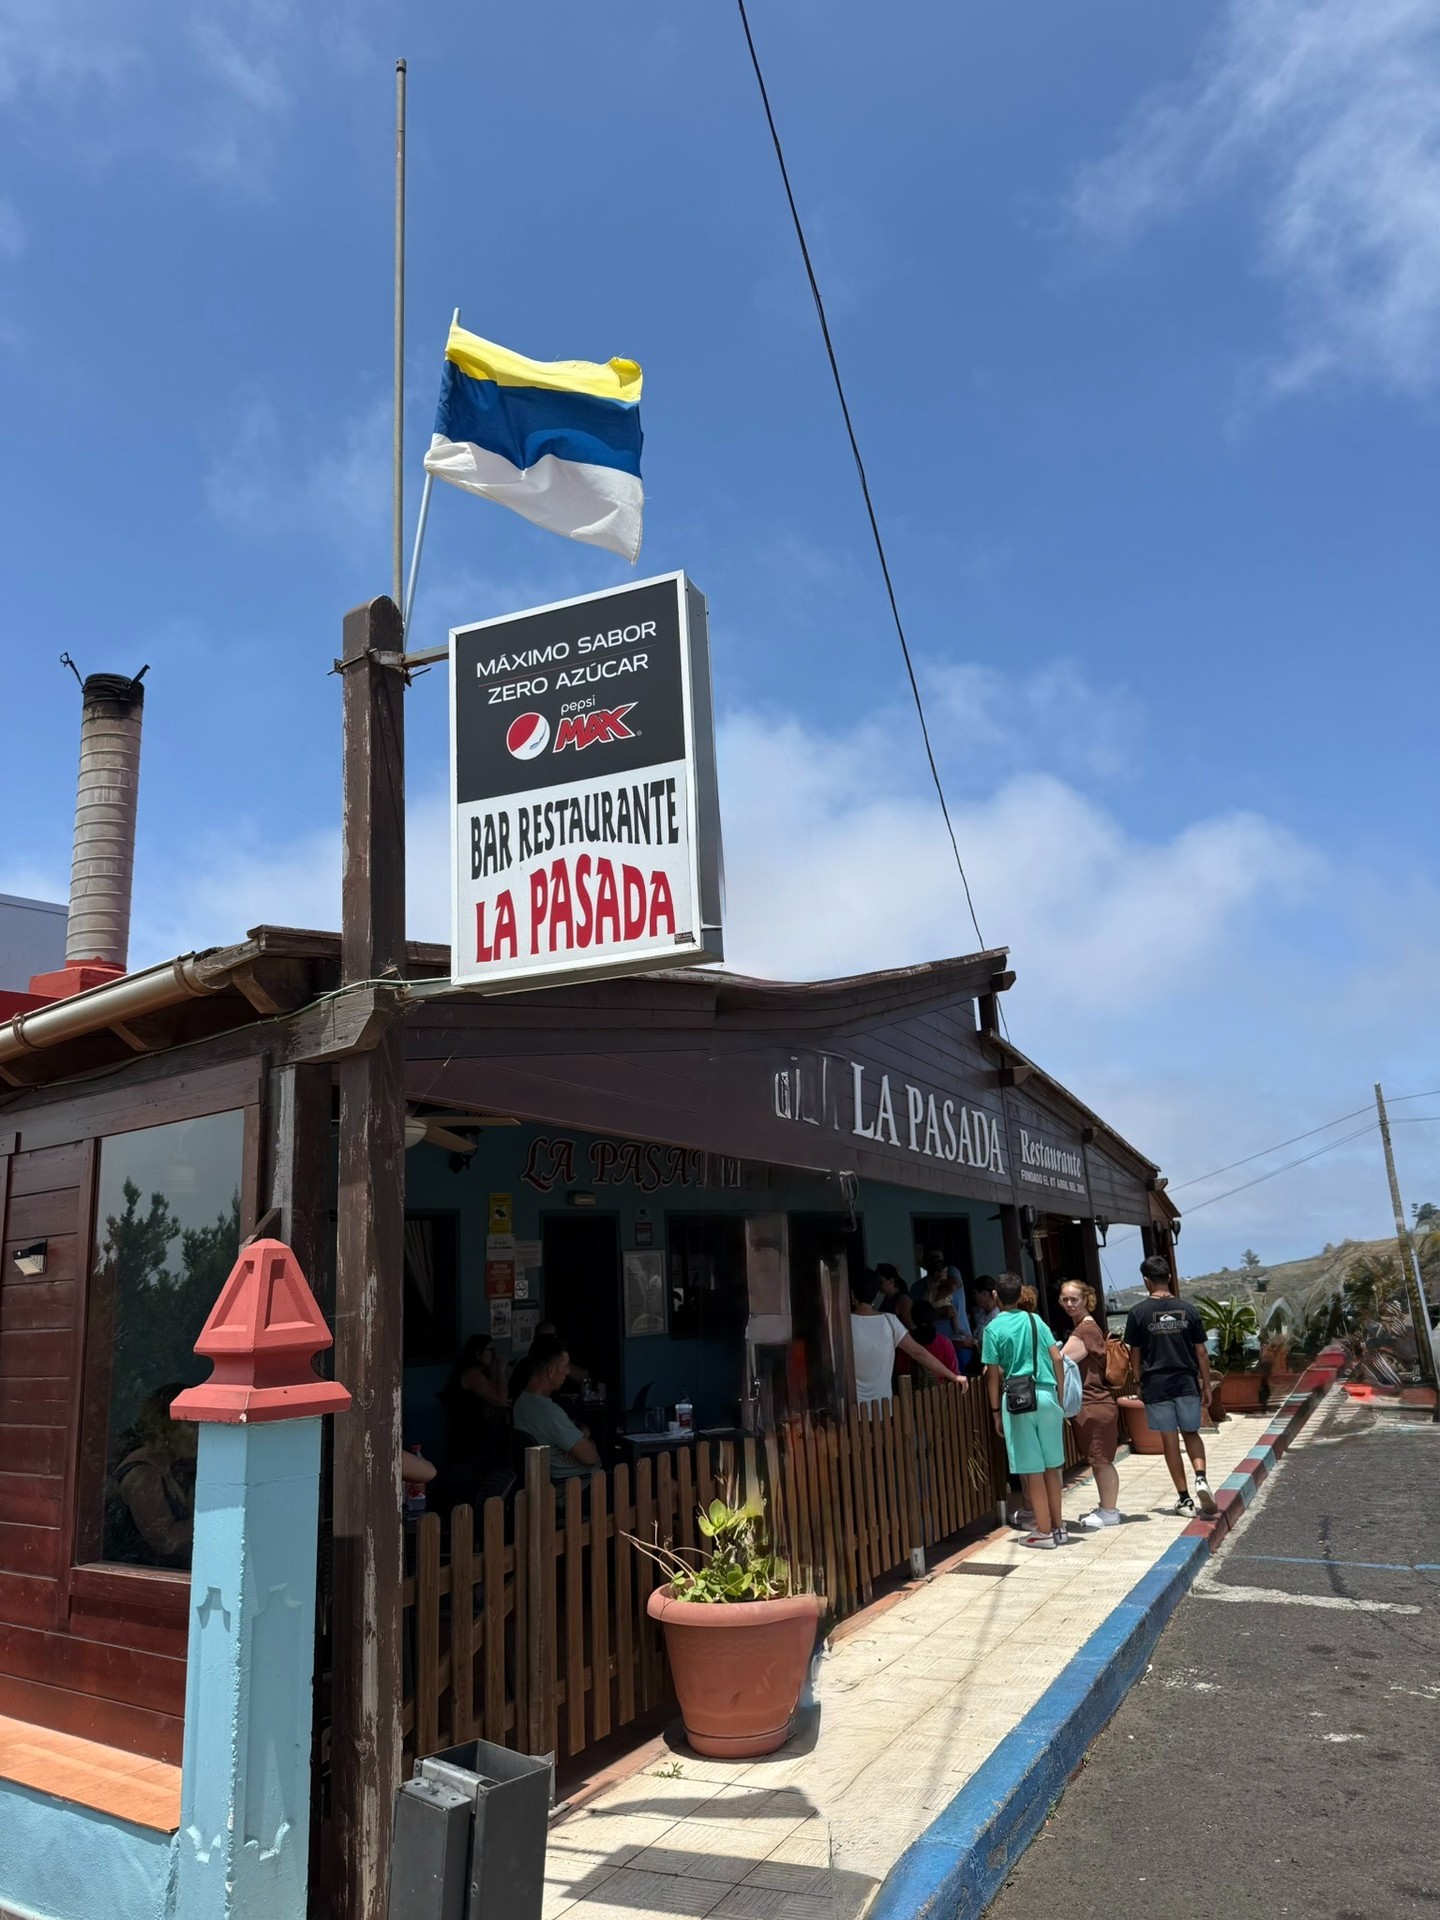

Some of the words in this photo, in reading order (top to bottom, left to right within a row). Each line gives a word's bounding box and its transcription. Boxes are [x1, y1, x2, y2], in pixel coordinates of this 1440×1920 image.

[476, 642, 570, 678] MÁXIMO
[577, 620, 658, 654] SABOR
[487, 676, 548, 705] ZERO
[555, 653, 649, 690] AZÚCAR
[560, 694, 596, 716] pepsi
[552, 701, 639, 753] MAX
[470, 808, 513, 880] BAR
[518, 777, 679, 861] RESTAURANTE
[475, 889, 518, 963] LA
[529, 853, 676, 955] PASADA
[850, 1061, 901, 1147] LA
[904, 1083, 1005, 1175] PASADA
[520, 1136, 579, 1194] LA
[1019, 1128, 1081, 1177] Restaurante
